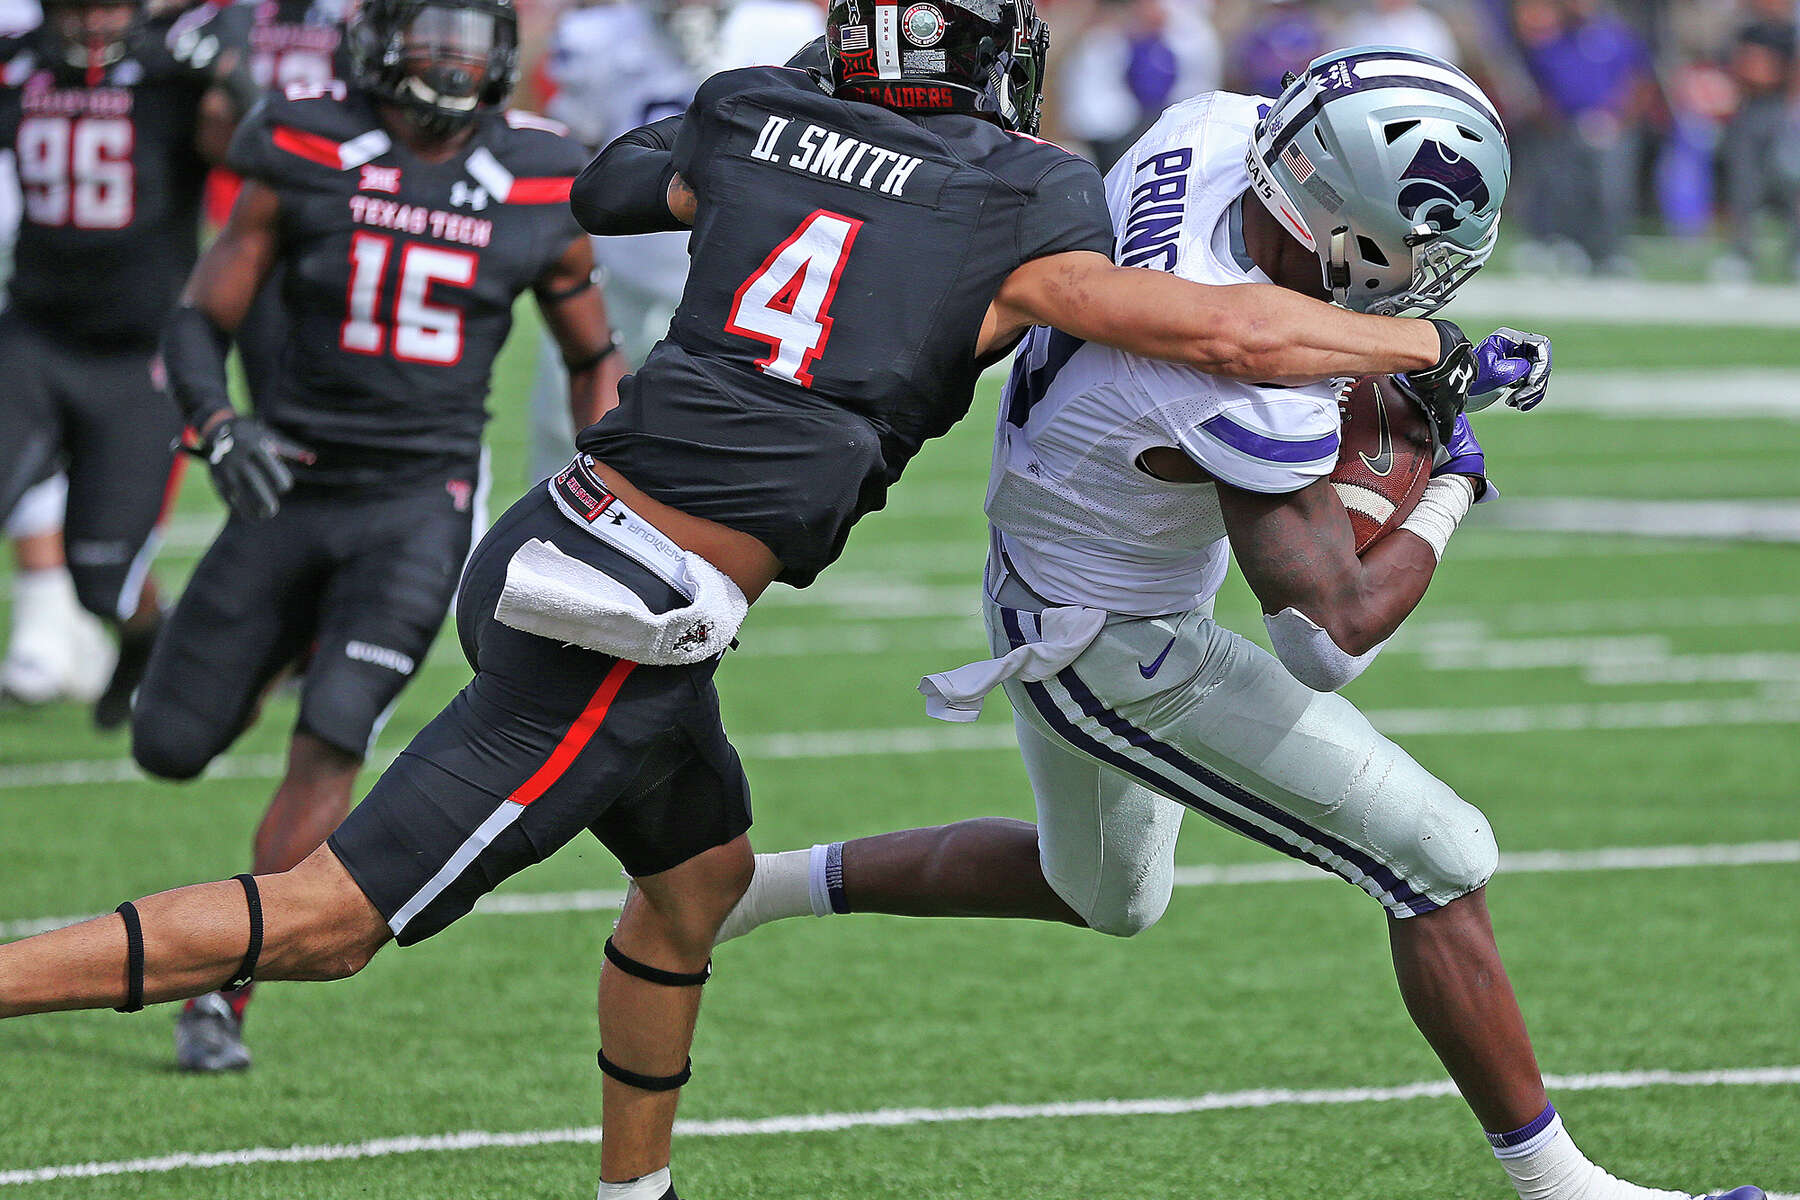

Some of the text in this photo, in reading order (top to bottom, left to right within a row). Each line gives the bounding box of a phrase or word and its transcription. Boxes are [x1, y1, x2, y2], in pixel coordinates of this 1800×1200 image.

[870, 87, 954, 108] RAIDERS
[16, 114, 138, 231] 96
[750, 114, 924, 197] D. SMITH
[350, 194, 493, 248] TEXAS TECH
[1120, 147, 1193, 272] PRING
[338, 228, 479, 367] 15
[723, 208, 865, 390] 4
[627, 523, 687, 562] ARMOUR
